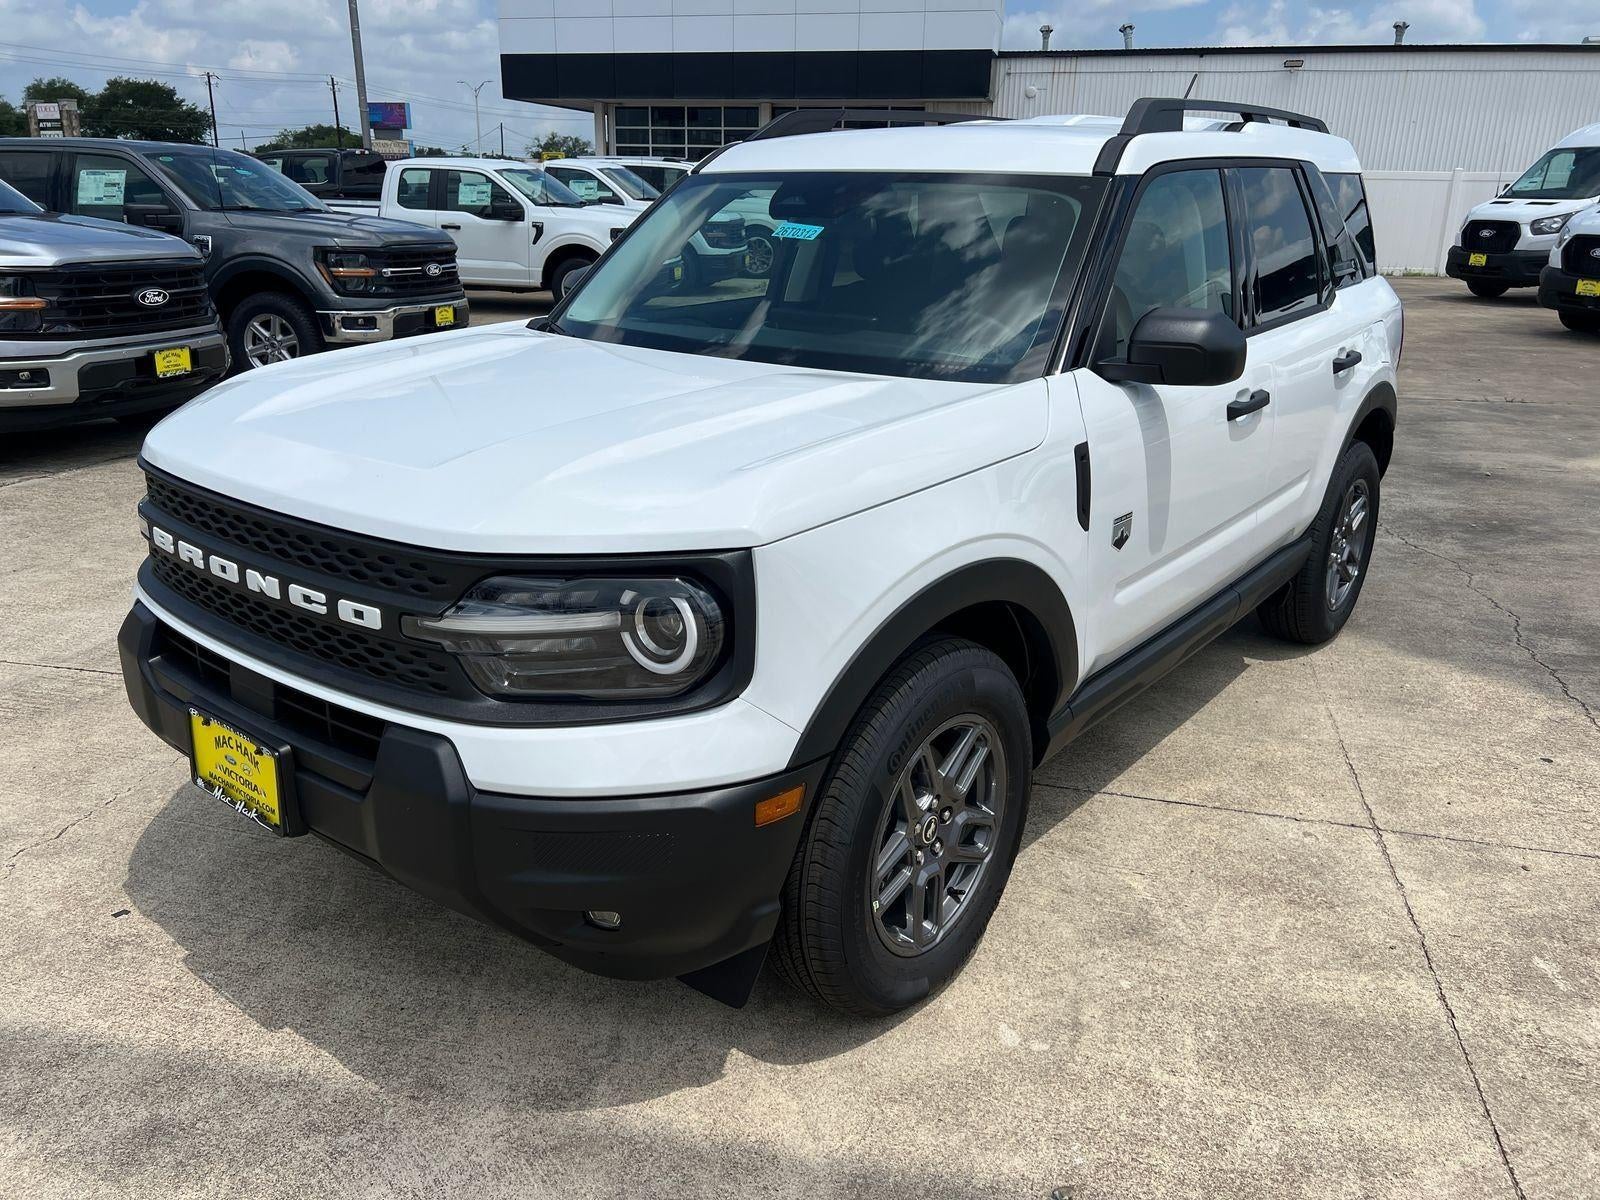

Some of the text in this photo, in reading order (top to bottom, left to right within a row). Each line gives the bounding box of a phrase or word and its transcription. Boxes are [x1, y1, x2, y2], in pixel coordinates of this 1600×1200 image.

[775, 226, 818, 239] 26T0312
[144, 292, 164, 304] Ford
[152, 526, 382, 630] BRONCO
[214, 735, 234, 750] MAC
[221, 765, 259, 793] VICTORIA
